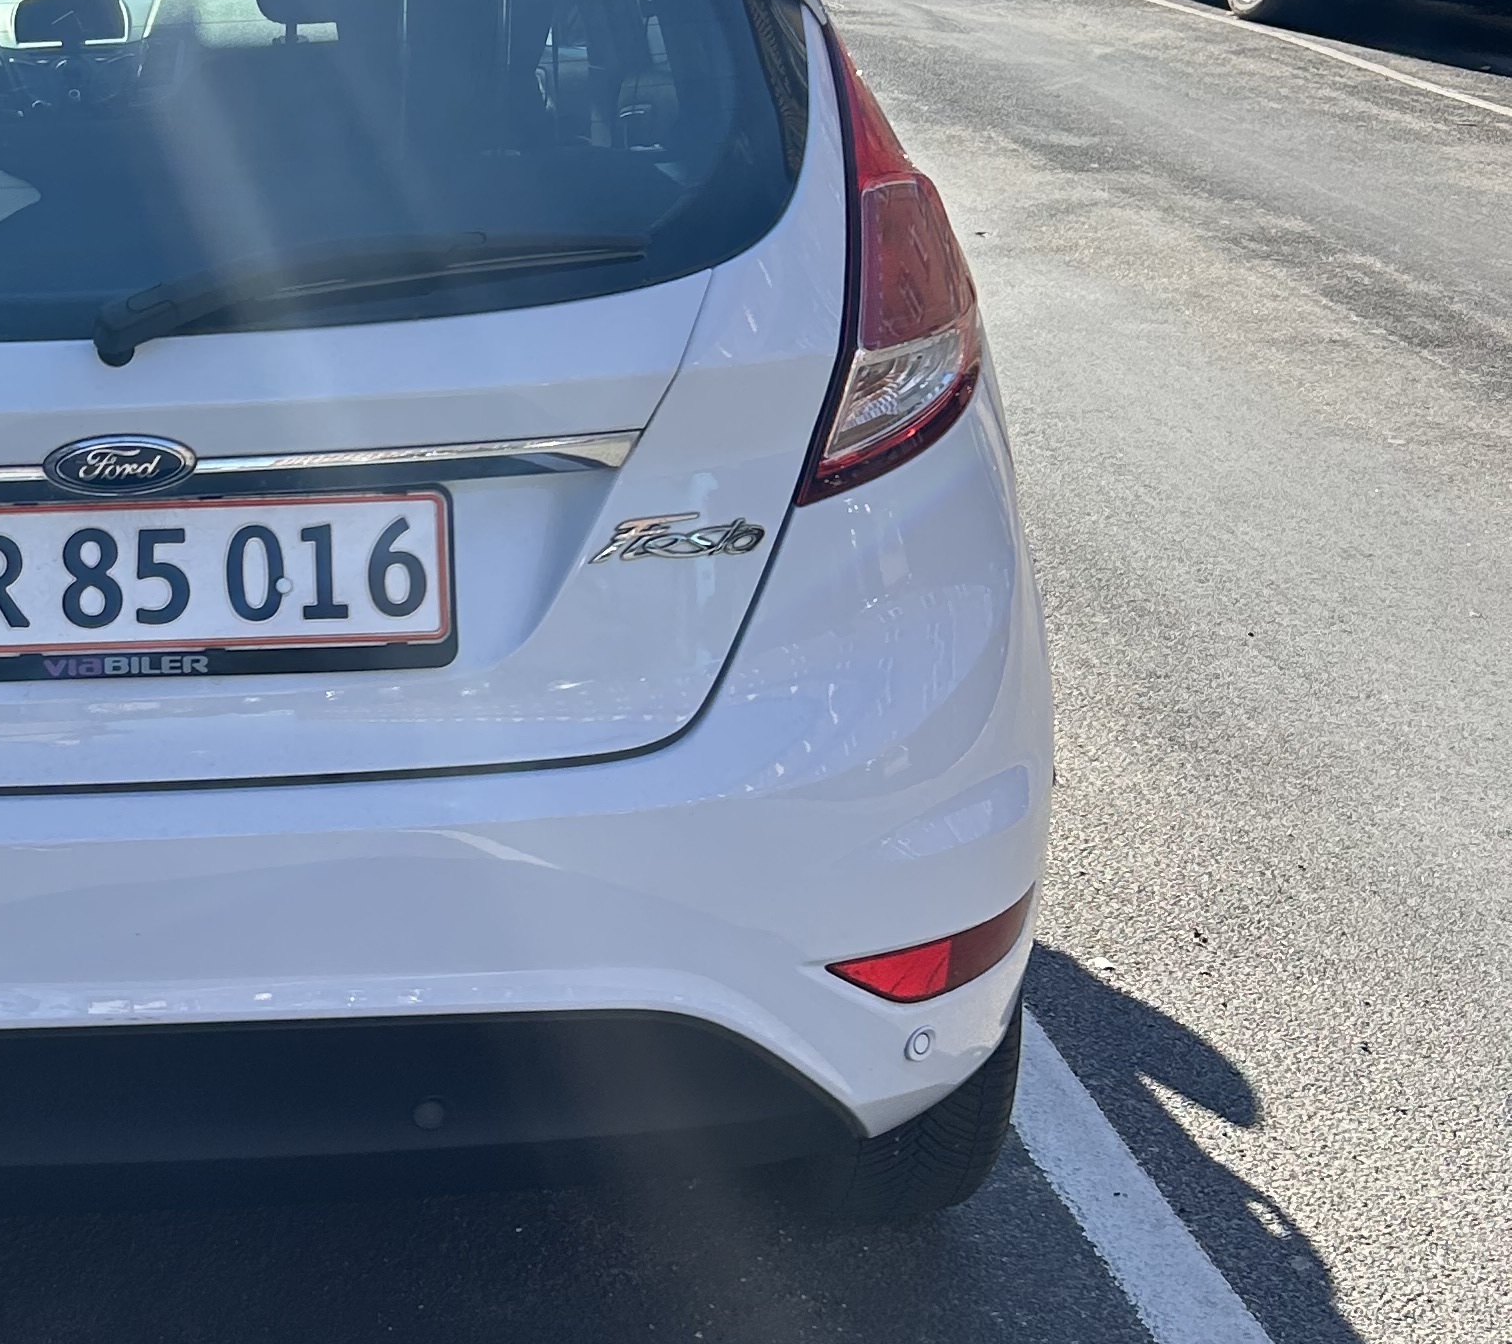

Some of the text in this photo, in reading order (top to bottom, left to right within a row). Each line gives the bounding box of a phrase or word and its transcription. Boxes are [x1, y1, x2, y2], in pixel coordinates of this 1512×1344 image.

[78, 449, 162, 482] Ford
[588, 512, 766, 562] Fiesta
[61, 527, 191, 629] 85
[226, 517, 428, 622] 016
